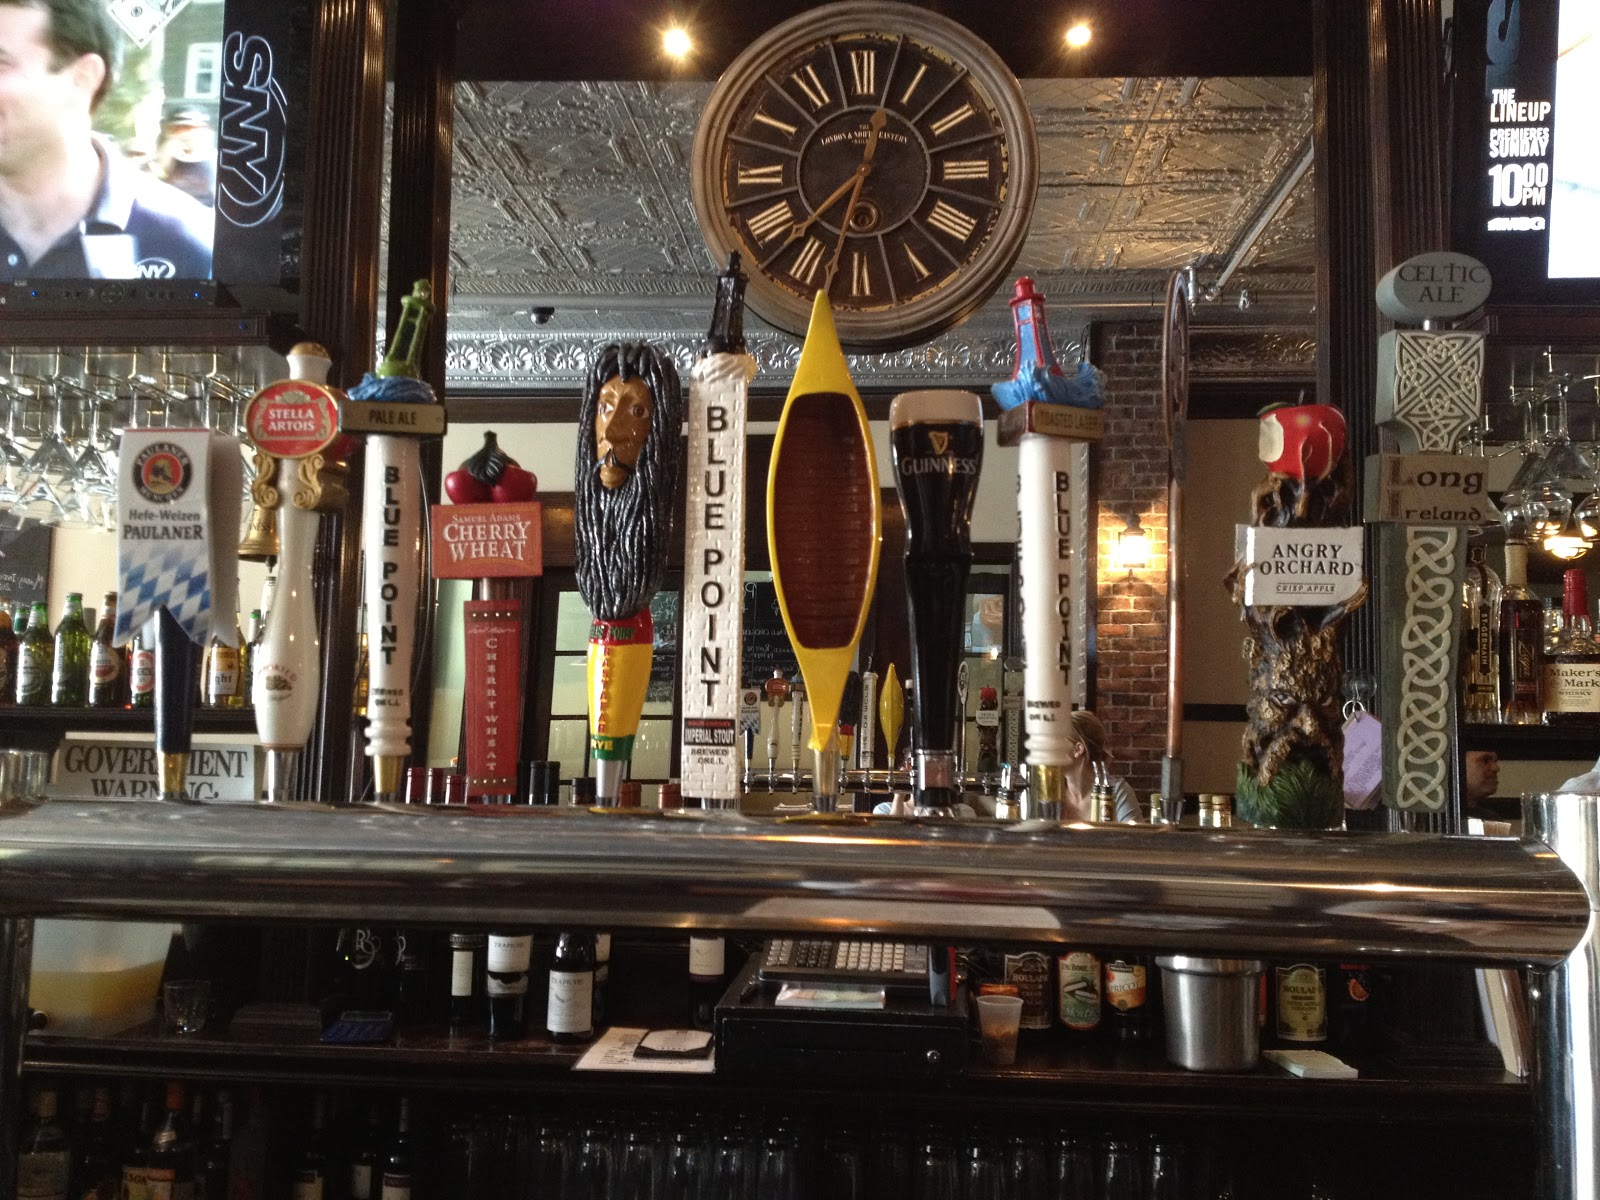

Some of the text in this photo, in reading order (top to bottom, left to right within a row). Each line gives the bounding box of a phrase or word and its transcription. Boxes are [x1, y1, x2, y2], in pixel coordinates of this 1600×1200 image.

[1491, 88, 1516, 104] THE
[1490, 102, 1551, 122] LINEUP
[821, 132, 847, 146] LONDON
[1490, 128, 1550, 142] PREMIERES
[1489, 139, 1549, 158] SUNDAY
[1522, 187, 1546, 206] PM
[1398, 263, 1487, 283] CELTIC
[1418, 286, 1465, 303] ALE
[268, 408, 315, 419] STELLA
[369, 410, 417, 425] PALE ALE
[268, 420, 316, 431] ARTOIS
[705, 406, 729, 530] BLUE
[901, 456, 978, 476] GUINNESS
[1386, 456, 1484, 495] Long
[383, 465, 401, 547] BLUE
[1385, 486, 1482, 520] Ireland
[128, 509, 202, 521] Hefe-Weizen
[452, 513, 521, 524] SAMUEL ADAMS
[1055, 471, 1071, 560] BLUE
[122, 524, 204, 540] PAULANER
[443, 521, 532, 542] CHERRY
[448, 540, 526, 563] WHEAT
[1272, 544, 1343, 559] ANGRY
[1260, 560, 1356, 576] ORCHARD
[1276, 584, 1336, 592] CRISP APPLE
[380, 562, 399, 665] POINT
[701, 548, 725, 707] POINT
[1057, 573, 1072, 686] POINT
[1564, 678, 1600, 688] Mark
[685, 728, 734, 744] IMPERIAL STOUT
[590, 738, 614, 751] RYE
[691, 748, 729, 756] BREWED
